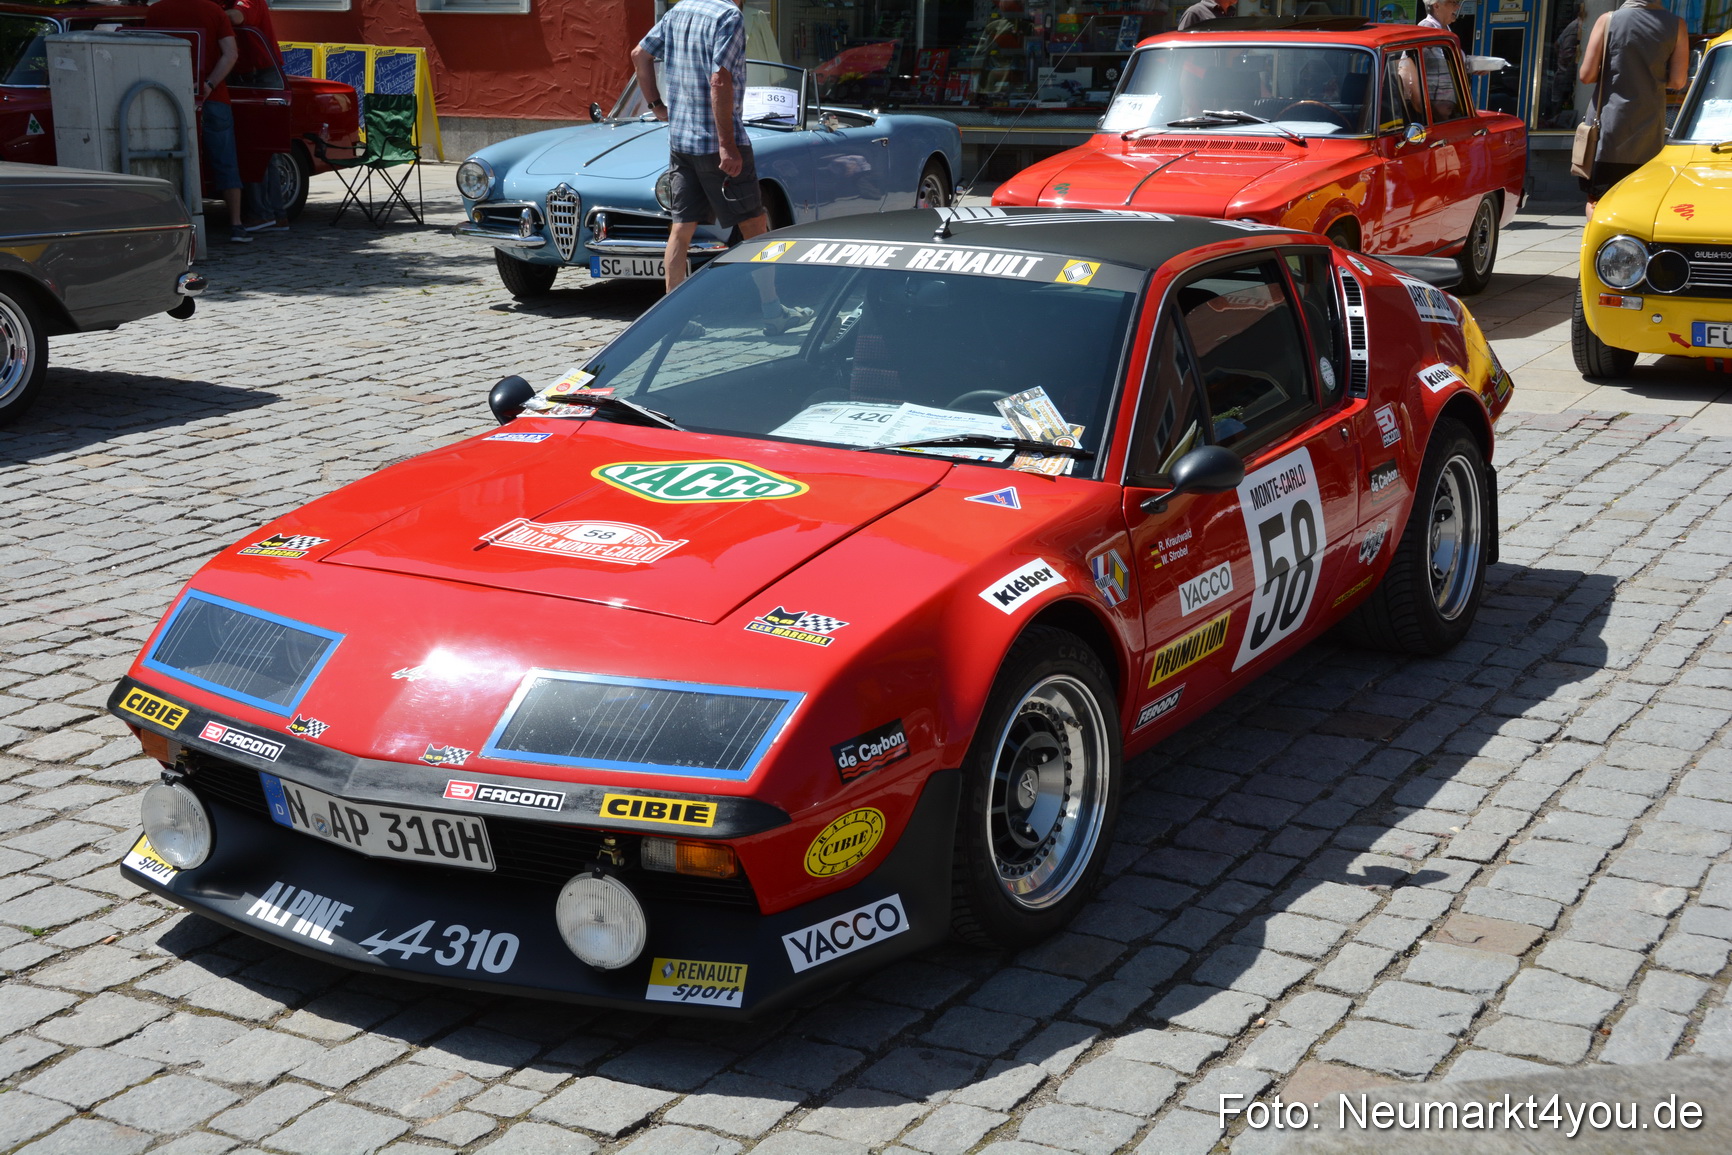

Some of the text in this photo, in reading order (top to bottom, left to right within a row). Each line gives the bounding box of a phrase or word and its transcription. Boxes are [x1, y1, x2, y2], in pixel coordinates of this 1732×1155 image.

[767, 94, 786, 103] 363
[601, 259, 622, 275] SC
[632, 260, 653, 276] LU
[797, 243, 1044, 278] ALPINE RENAULT
[848, 412, 893, 424] 420
[1382, 427, 1400, 447] FACOM
[615, 466, 781, 497] YACCO
[1250, 463, 1307, 511] MONTE-CARLO
[1371, 468, 1398, 492] de Carbon
[502, 525, 668, 561] RALLYE MONTE-CARLO
[583, 529, 616, 539] 58
[1158, 528, 1193, 551] R. Krautwald
[1162, 545, 1189, 565] W. Strobel
[992, 567, 1054, 607] kléber
[1181, 566, 1230, 610] YACCO
[1250, 499, 1317, 650] 58
[771, 627, 828, 645] MARCHAL
[1151, 616, 1228, 683] PROMOTION
[1138, 693, 1180, 726] FERODO
[222, 731, 279, 758] FACOM
[838, 731, 905, 768] de Carbon
[478, 787, 560, 809] FACOM
[282, 784, 488, 864] N AP 310H
[818, 811, 879, 844] RACING
[138, 856, 175, 878] sport
[819, 851, 864, 873] TEAM
[246, 881, 354, 945] ALPINE
[789, 902, 901, 964] YACCO
[676, 962, 743, 983] RENAULT
[672, 982, 740, 1001] sport
